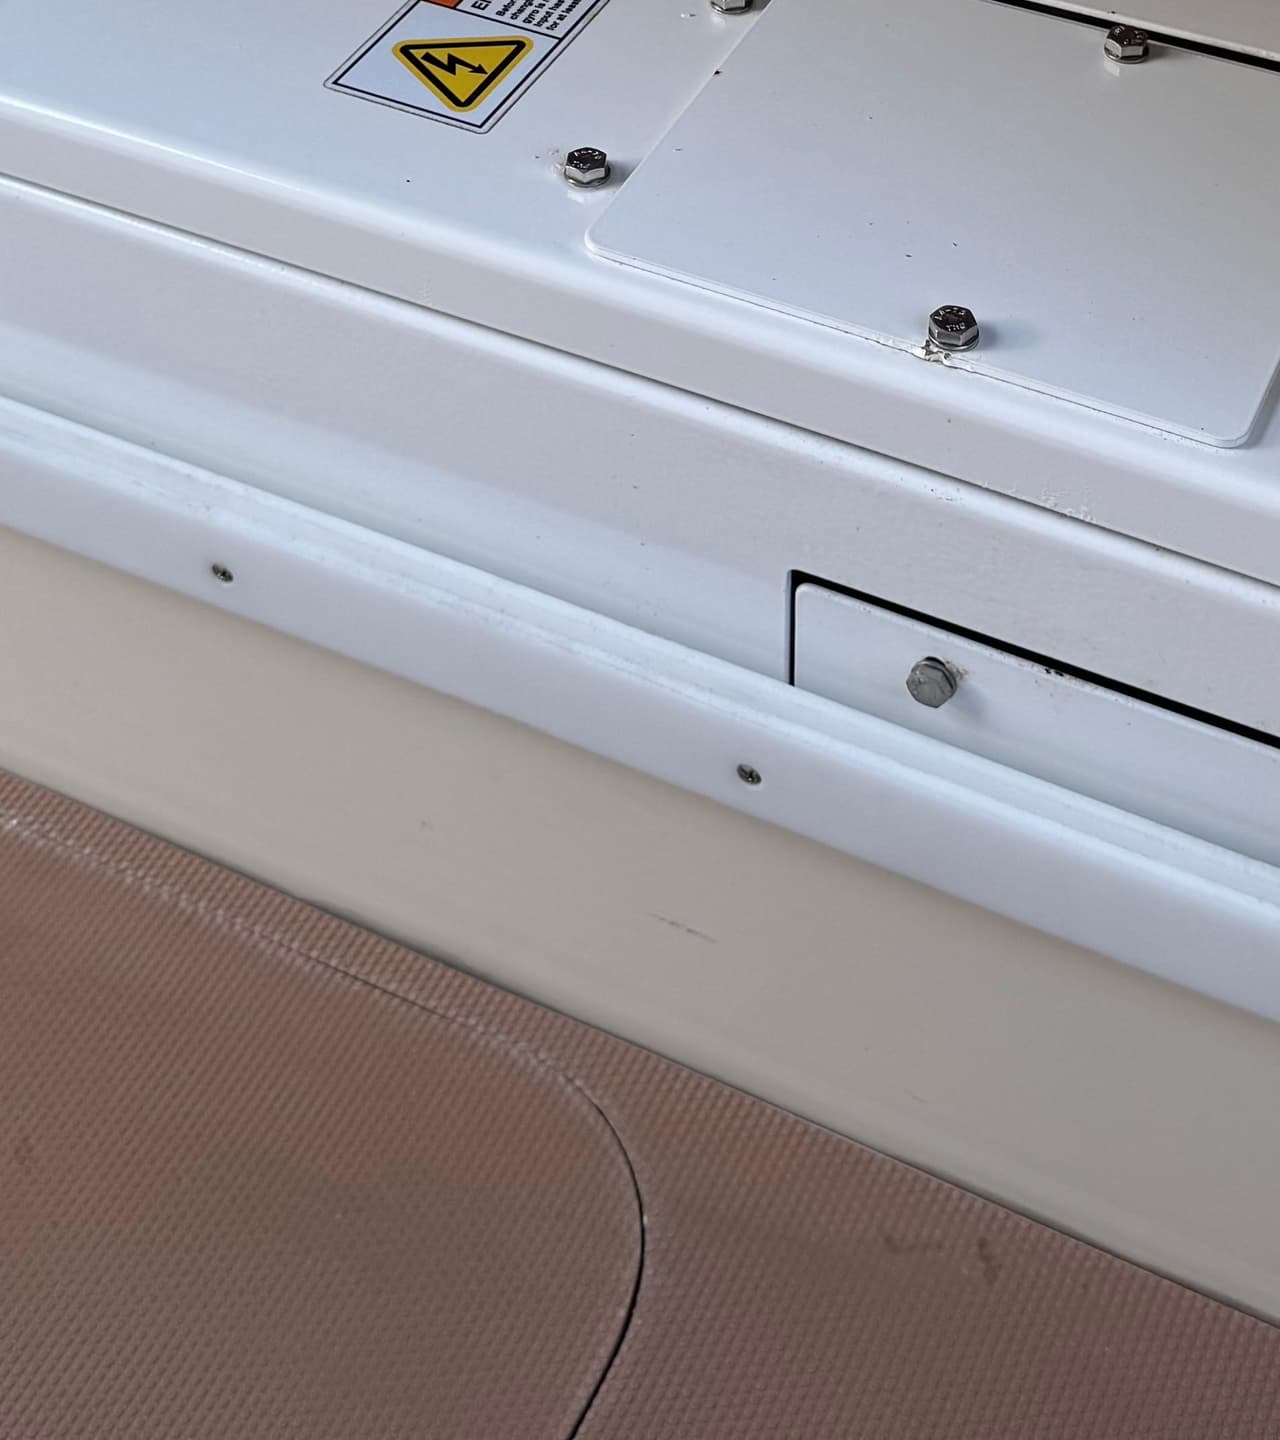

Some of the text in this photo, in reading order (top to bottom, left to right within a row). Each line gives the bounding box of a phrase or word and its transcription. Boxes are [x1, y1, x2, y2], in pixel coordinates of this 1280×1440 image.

[548, 0, 565, 11] has
[522, 9, 540, 24] gyro
[546, 21, 560, 31] for
